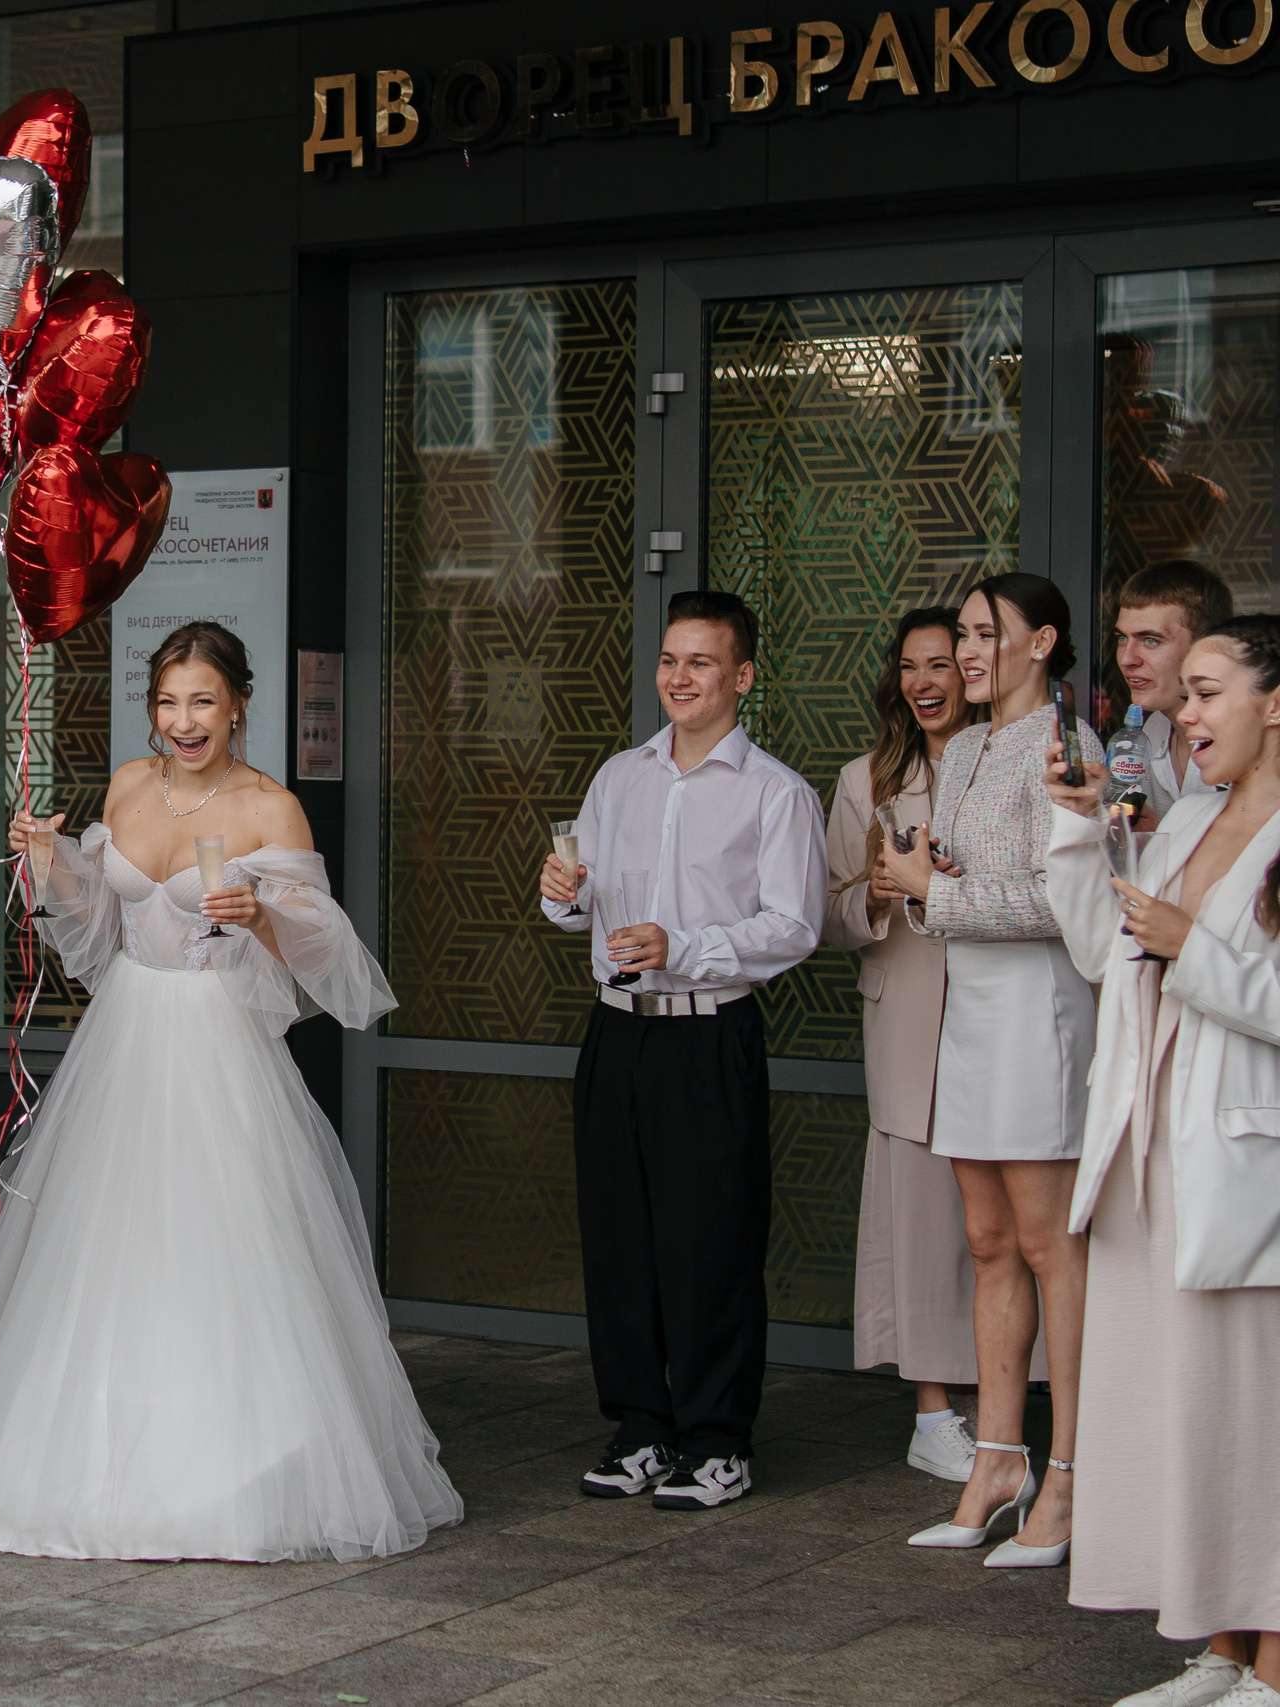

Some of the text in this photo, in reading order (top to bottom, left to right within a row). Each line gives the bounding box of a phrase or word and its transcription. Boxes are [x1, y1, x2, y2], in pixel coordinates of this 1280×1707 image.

[303, 0, 1273, 172] ДВОРЕЦ БРАКОСО
[152, 536, 269, 554] КОСОЧЕТАНИЯ
[127, 616, 150, 628] ВИД
